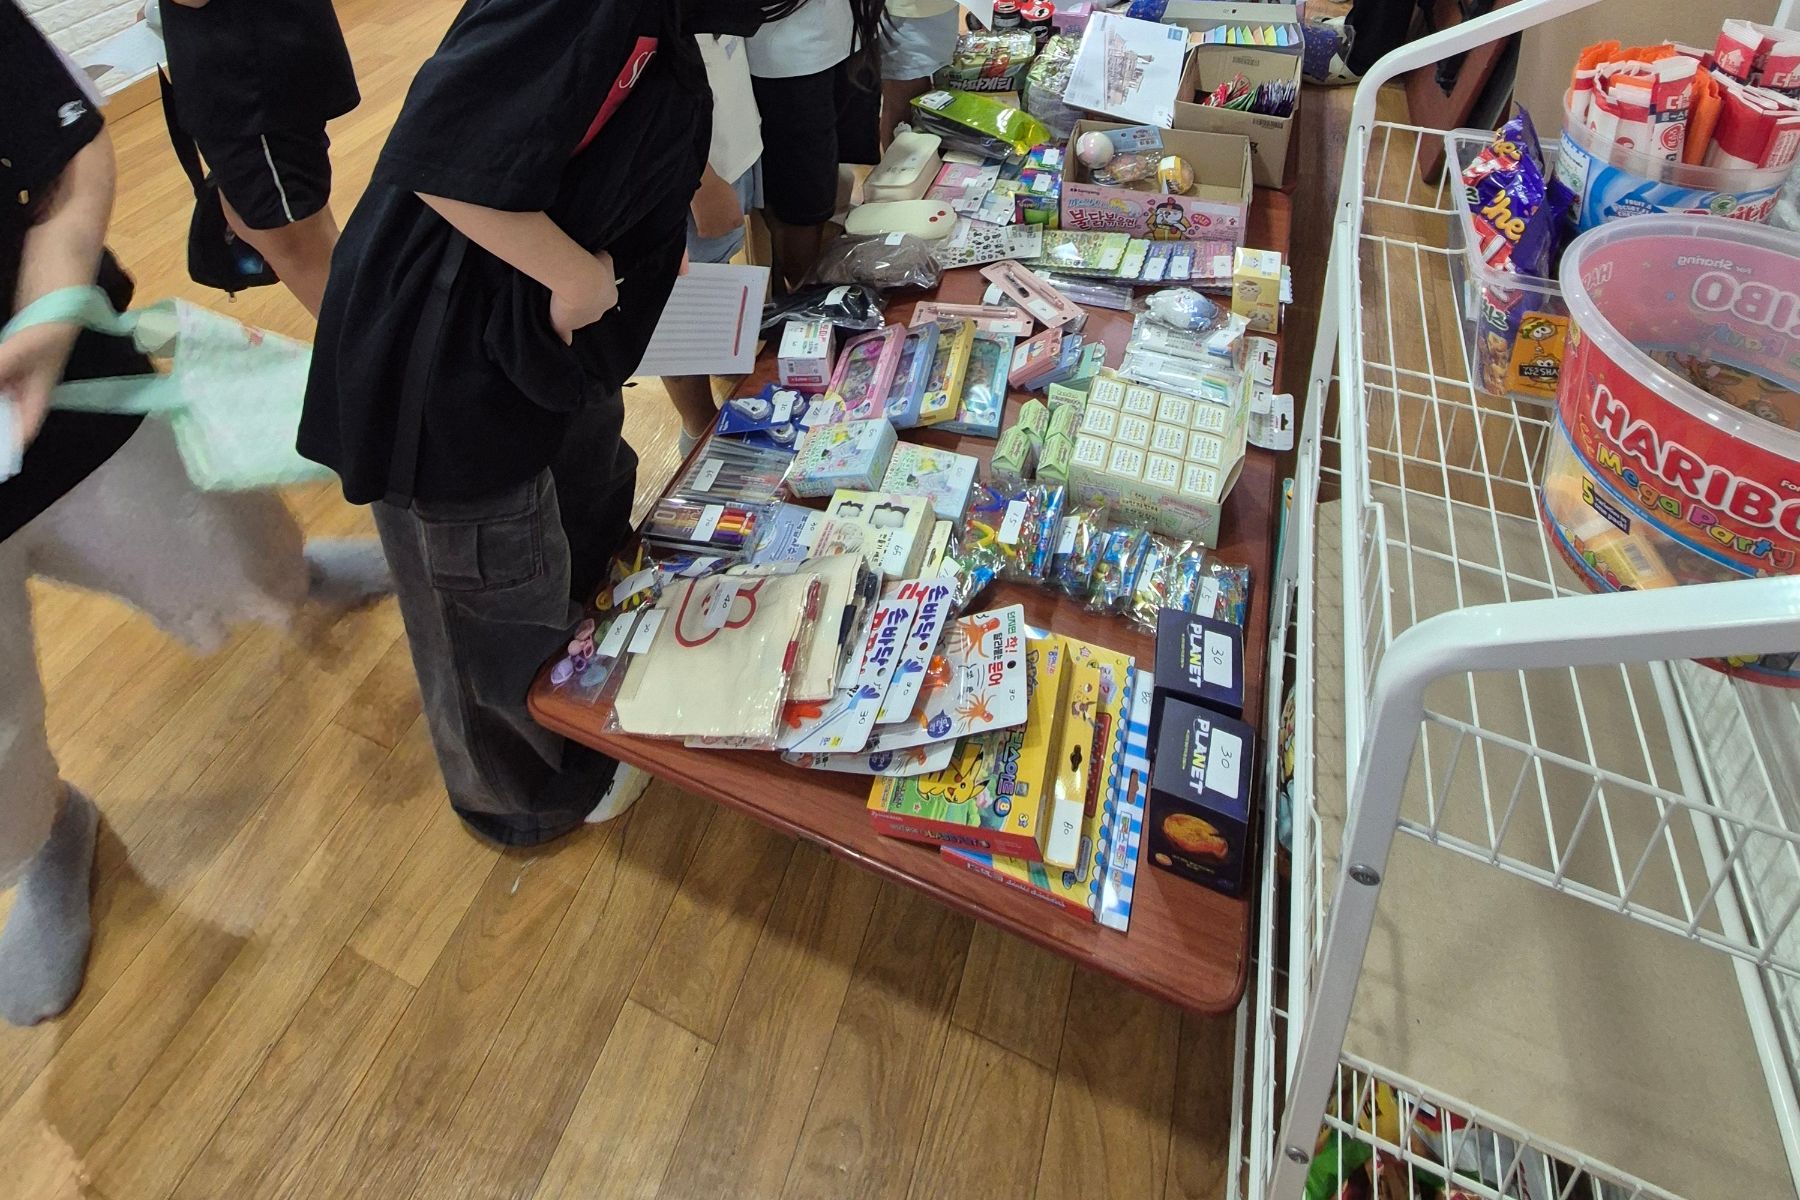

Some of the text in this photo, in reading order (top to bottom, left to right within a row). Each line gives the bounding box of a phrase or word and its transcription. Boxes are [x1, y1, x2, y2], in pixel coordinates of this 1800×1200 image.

[1068, 208, 1138, 230] 불닭볶음면
[1582, 476, 1595, 506] 5
[1687, 503, 1796, 570] Party
[911, 585, 949, 642] 손바닥
[870, 607, 910, 670] 손바닥
[1004, 635, 1019, 654] 착!
[1189, 623, 1203, 689] PLANET
[1210, 646, 1223, 666] 30
[987, 661, 1004, 687] 문어
[857, 710, 870, 726] 30
[1189, 717, 1211, 796] PLANET
[1220, 745, 1233, 770] 30
